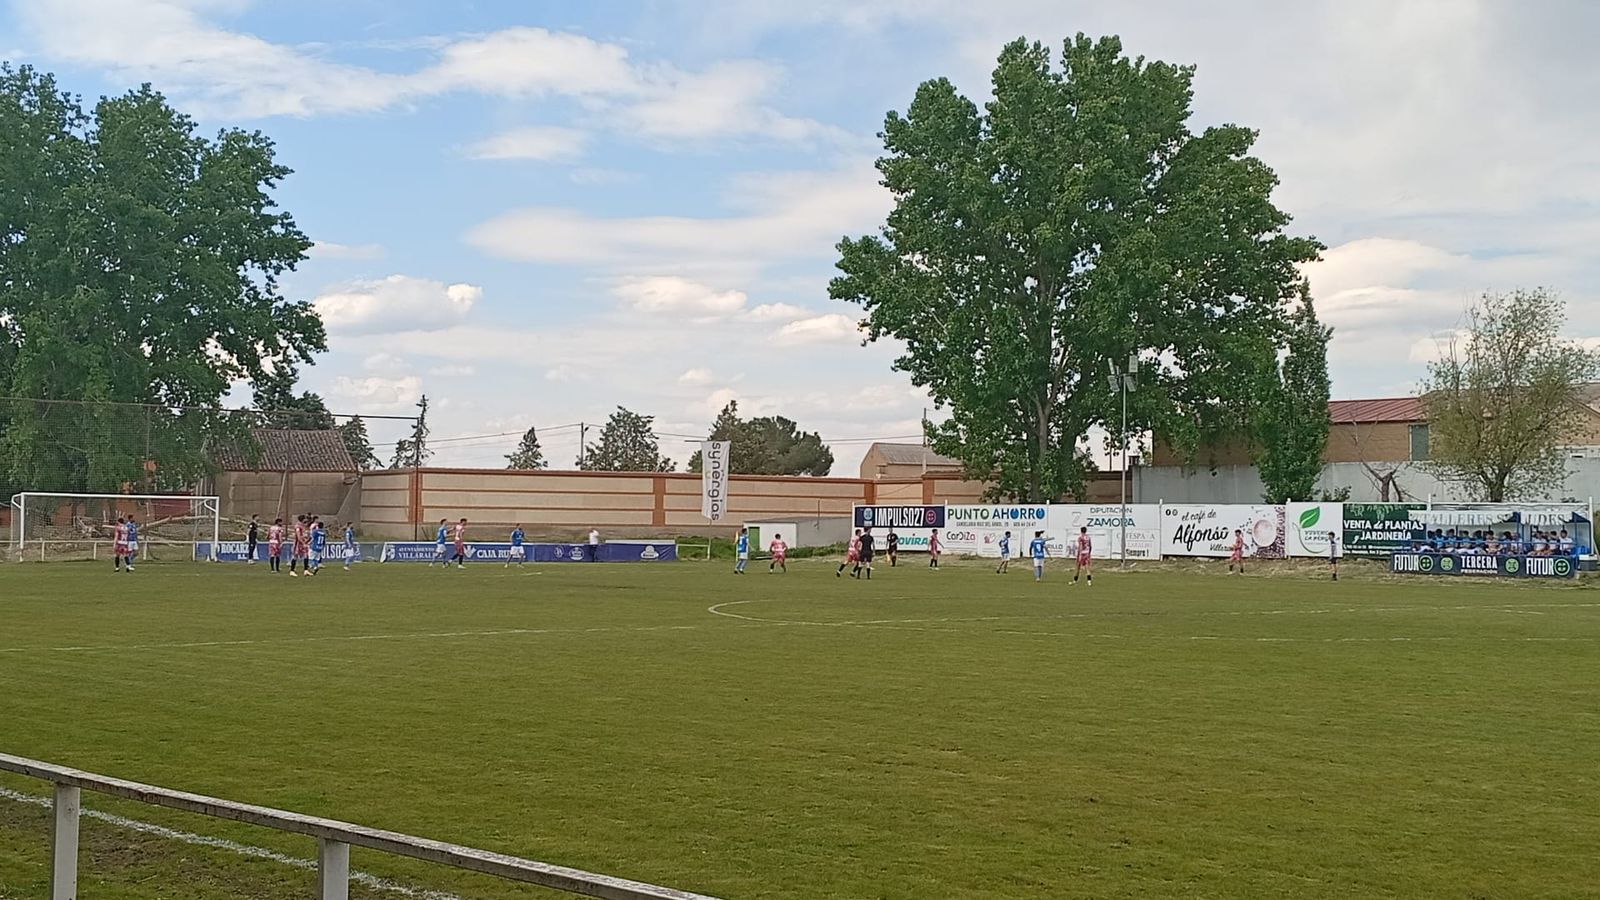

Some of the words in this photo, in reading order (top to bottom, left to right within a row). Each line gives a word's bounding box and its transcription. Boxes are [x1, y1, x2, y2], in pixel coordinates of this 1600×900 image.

[707, 442, 722, 520] synergias
[875, 507, 925, 526] IMPULSO27
[947, 508, 990, 519] PUNTO
[992, 508, 1045, 520] AHORRO
[1086, 518, 1136, 527] ZAMORA
[1344, 520, 1372, 529] VENTA
[1384, 520, 1424, 530] PLANTAS
[1361, 530, 1412, 540] JARDINERÍA
[1460, 555, 1498, 569] TERCERA
